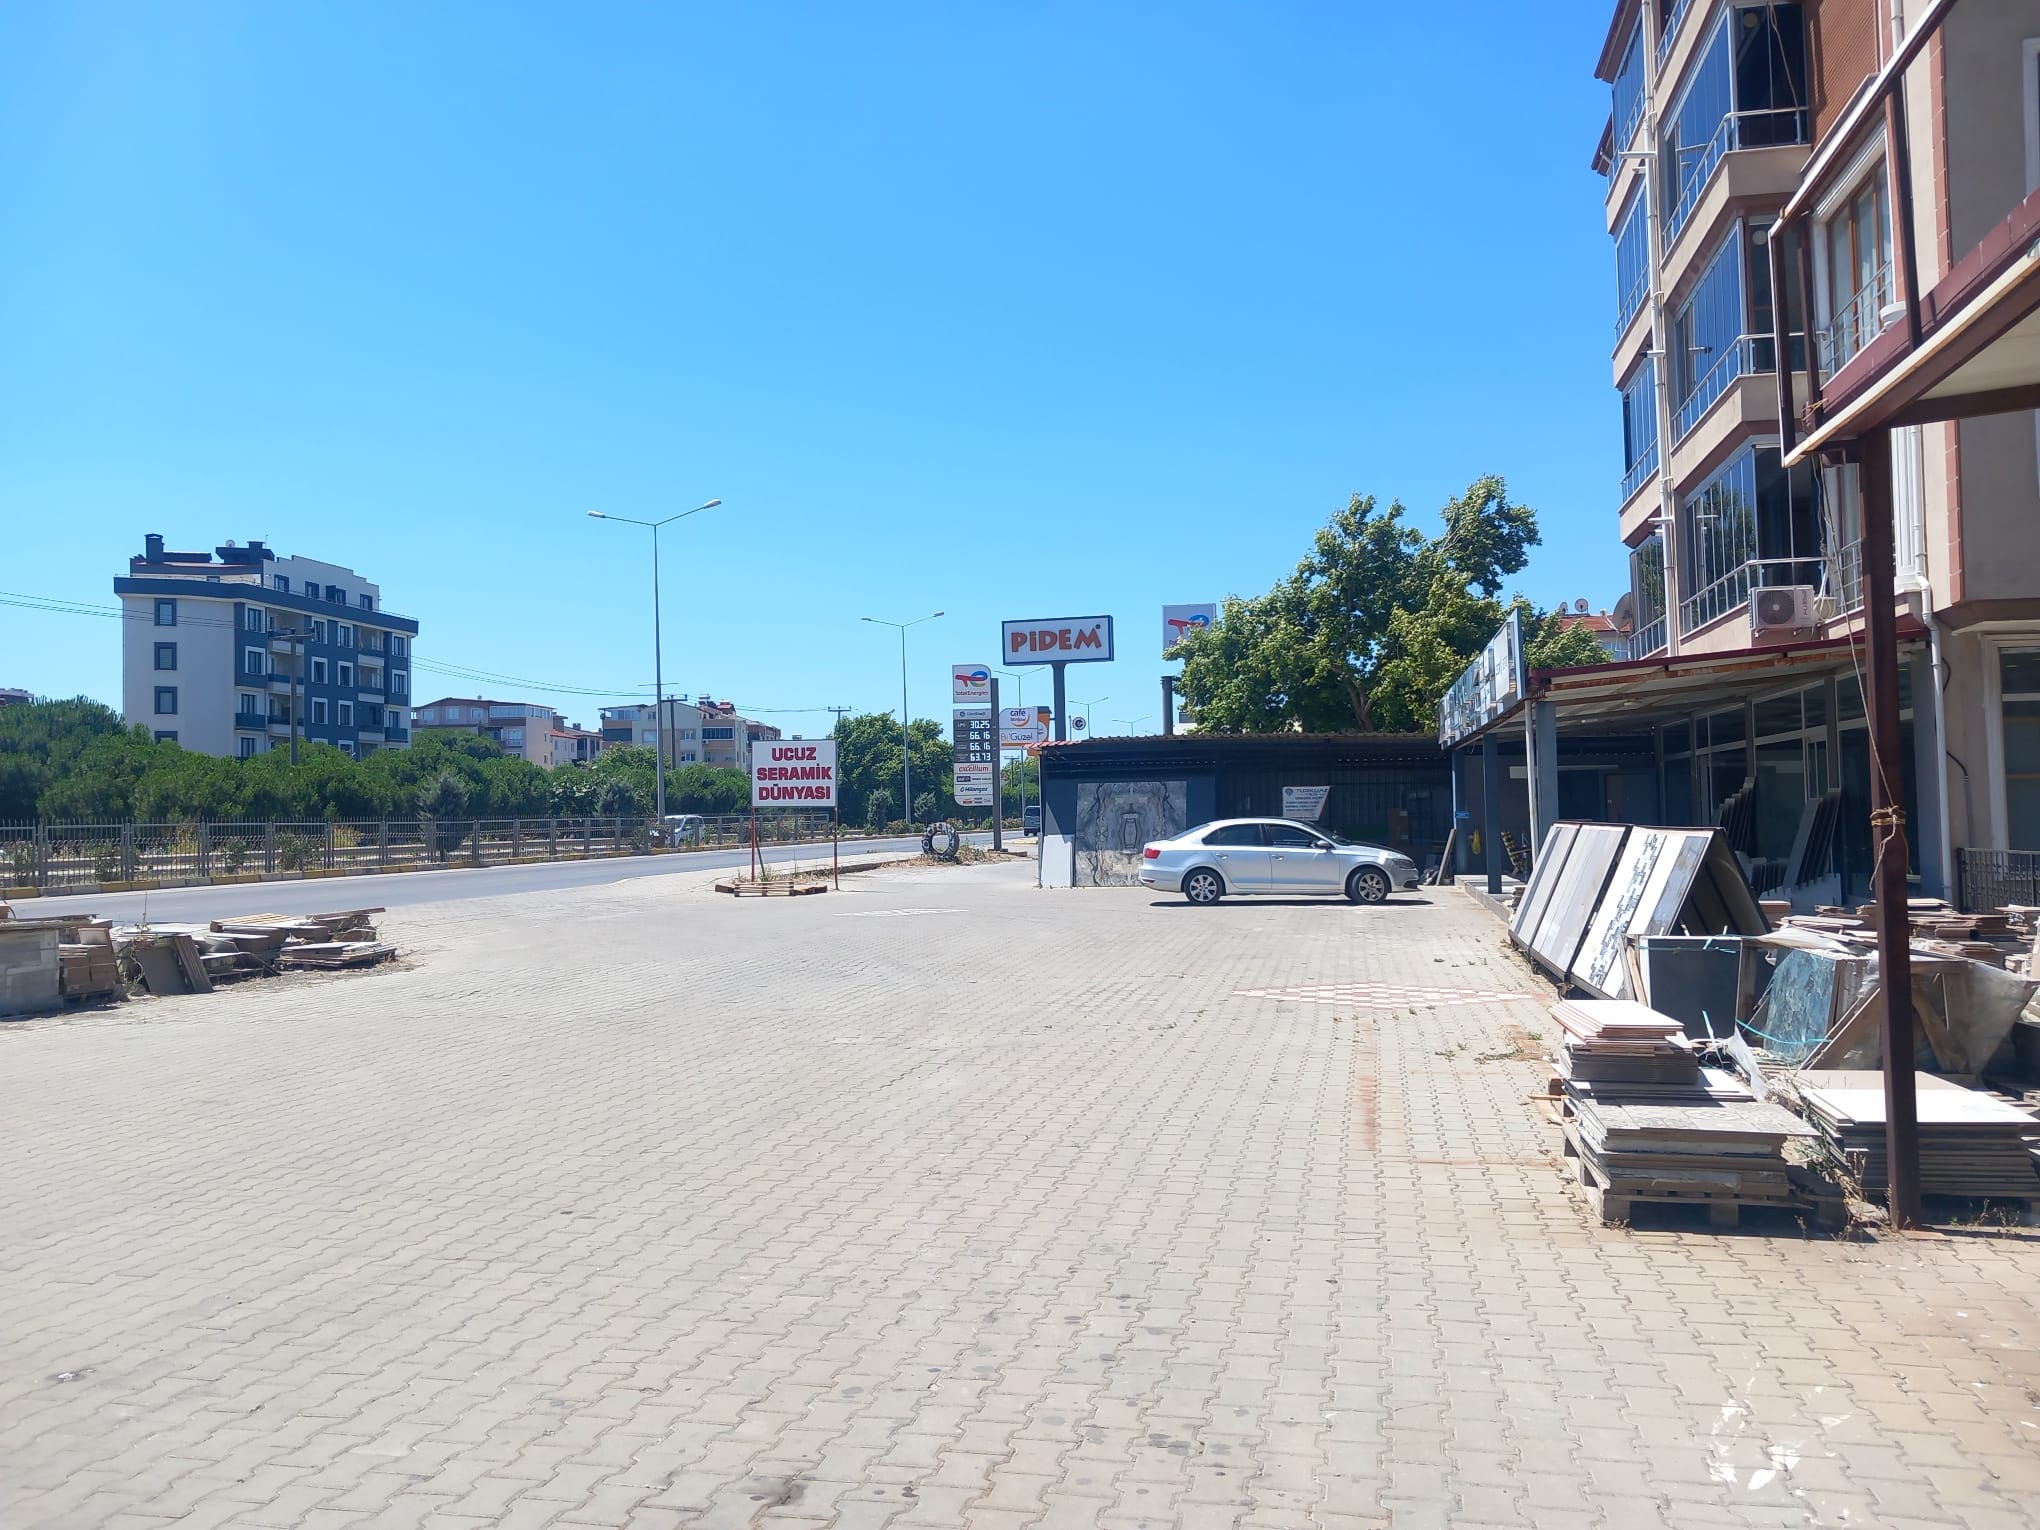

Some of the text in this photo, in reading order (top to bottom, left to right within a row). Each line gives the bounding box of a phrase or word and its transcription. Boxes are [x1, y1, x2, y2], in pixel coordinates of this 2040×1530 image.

[970, 731, 991, 740] 66.16
[970, 742, 991, 751] 66.16
[771, 747, 817, 761] UCUZ
[757, 763, 833, 781] SERAMİK
[758, 783, 831, 801] DÜNYASI
